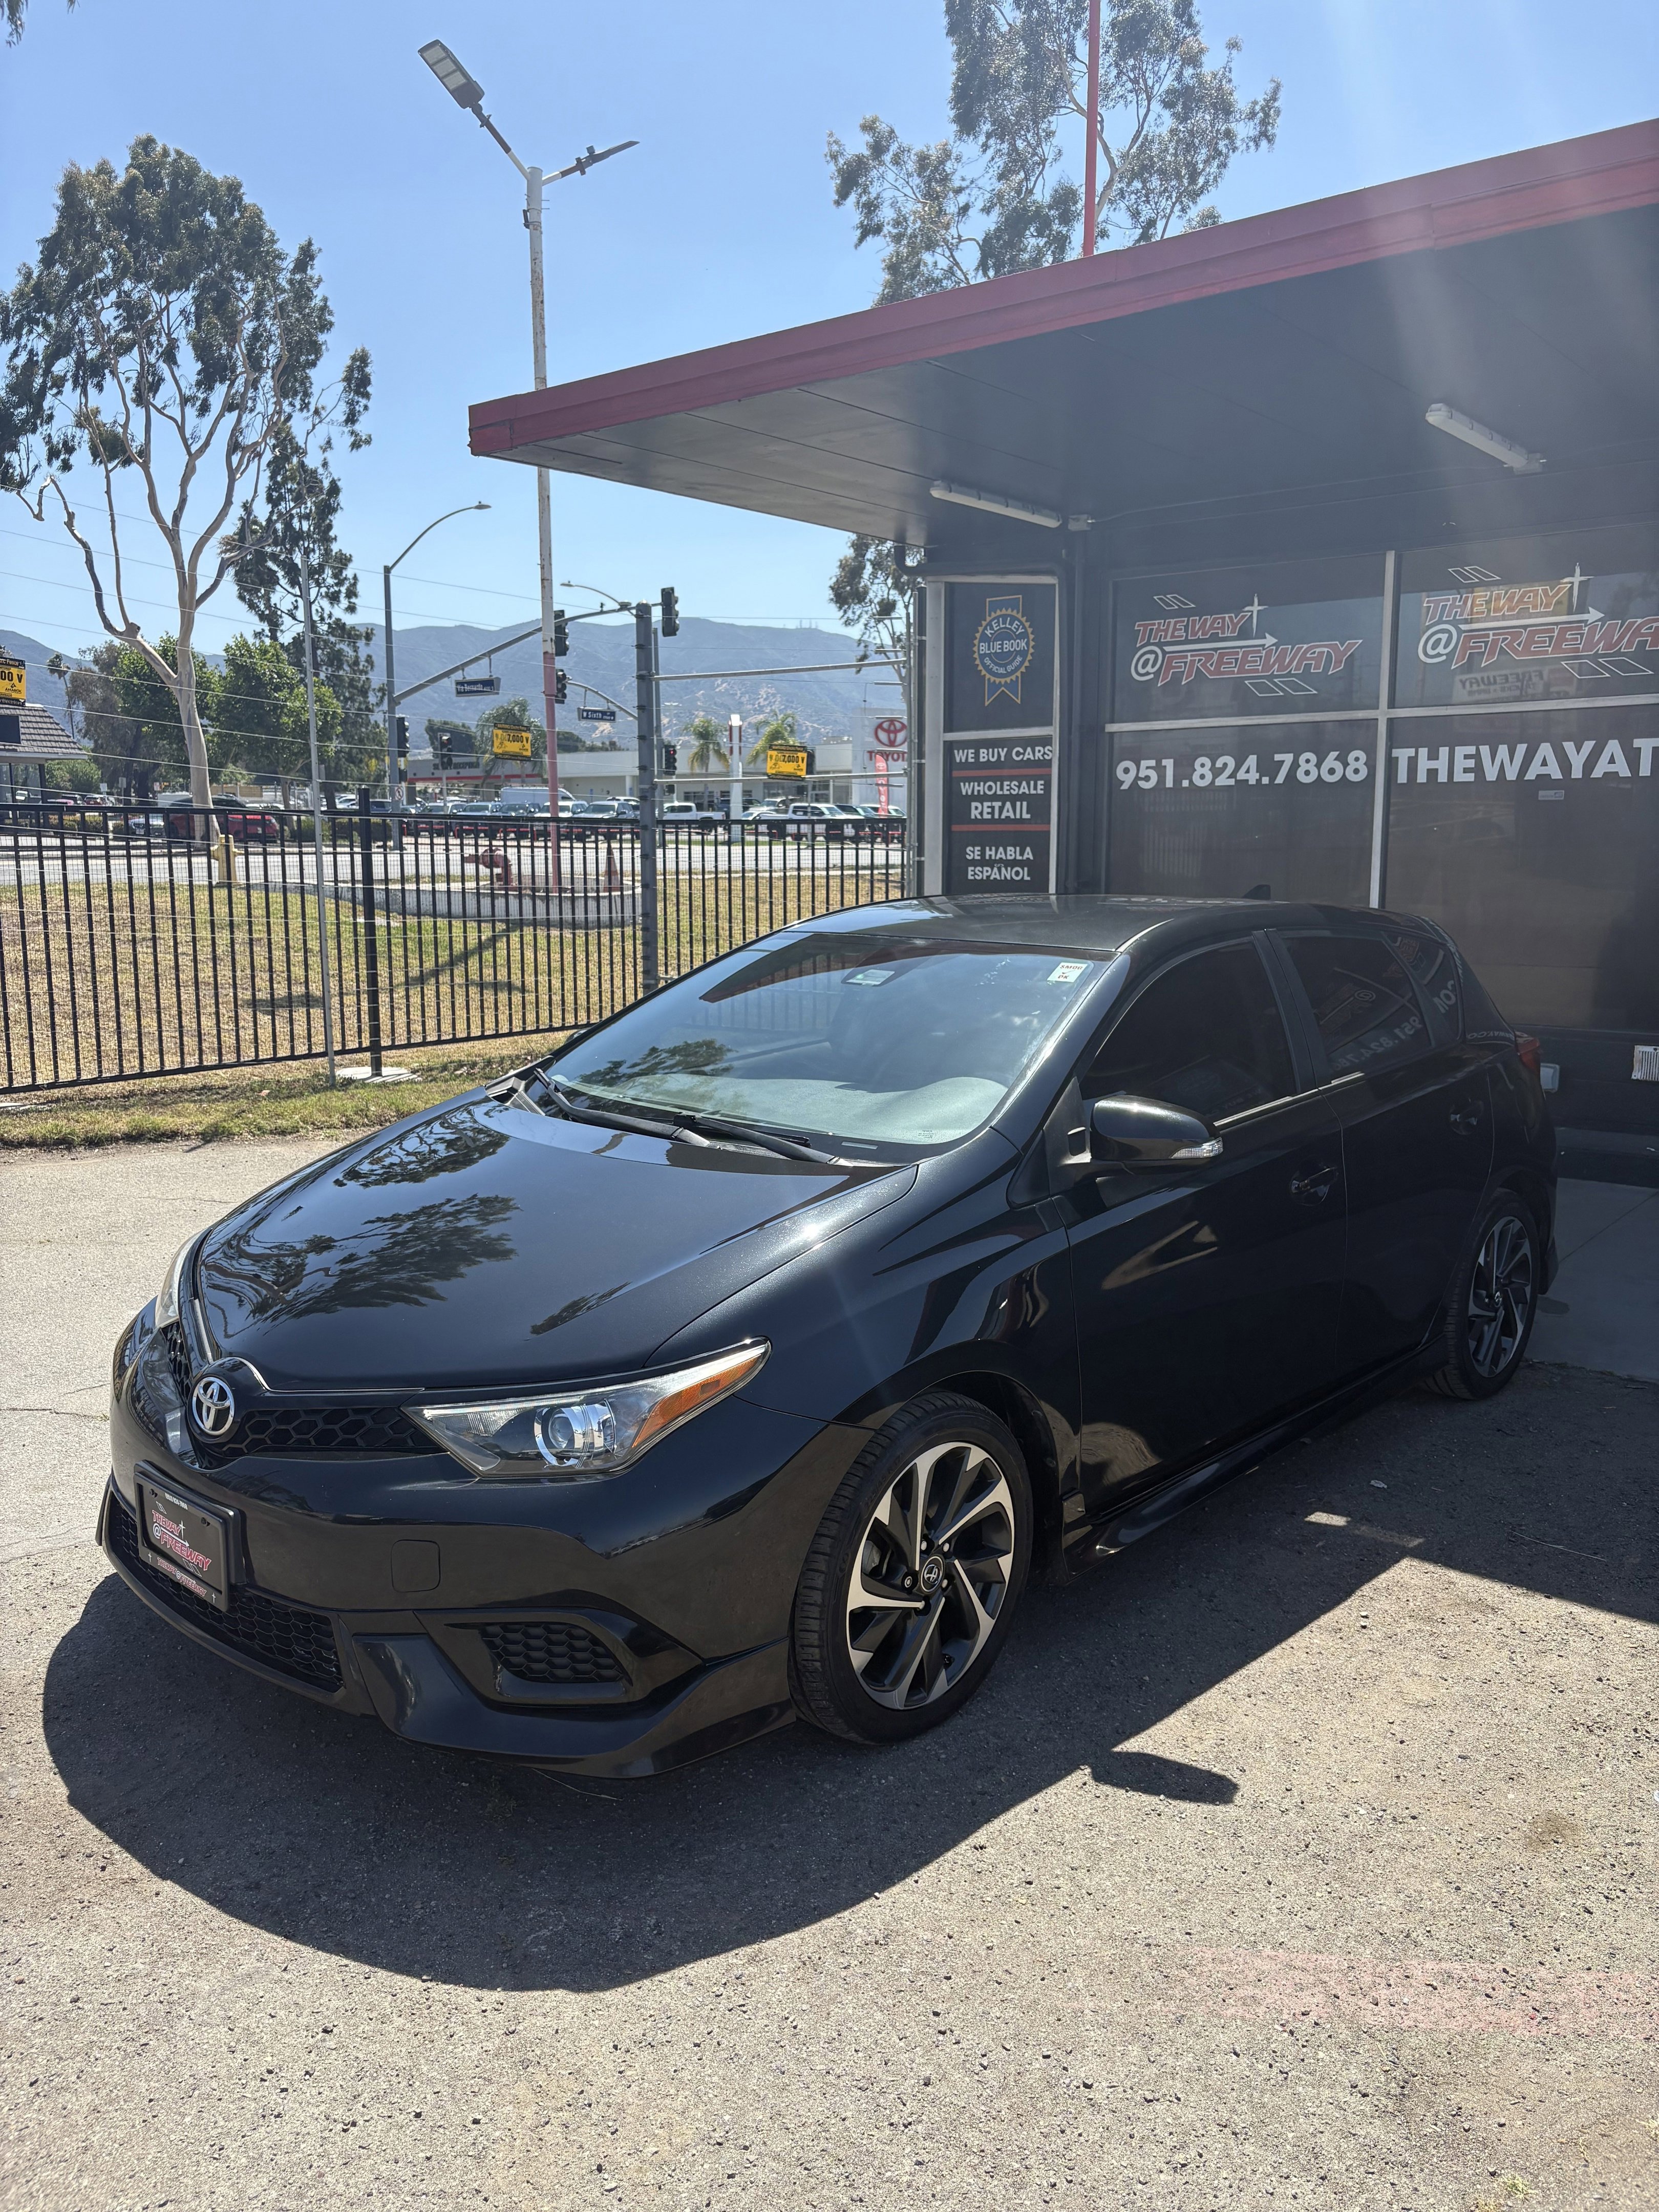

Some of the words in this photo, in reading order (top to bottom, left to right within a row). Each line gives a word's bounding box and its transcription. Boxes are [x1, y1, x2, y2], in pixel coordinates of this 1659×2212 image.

[984, 617, 1025, 637] KELLEY
[980, 642, 1002, 654] BLUE
[1003, 639, 1027, 652] BOOK
[984, 657, 1007, 673] OFFICIAL
[1006, 655, 1023, 672] GUIDE
[17, 673, 23, 683] V
[954, 749, 975, 762] WE
[980, 748, 1008, 762] BUY
[1012, 746, 1053, 760] CARS
[1392, 738, 1659, 783] THEWAYAT
[1116, 750, 1368, 790] 951.824.7868
[960, 780, 1045, 795] WHOLESALE
[971, 801, 1031, 819] RETAIL
[966, 846, 981, 860] SE
[986, 846, 1033, 860] HABLA
[968, 863, 1031, 880] ESPAÑOL
